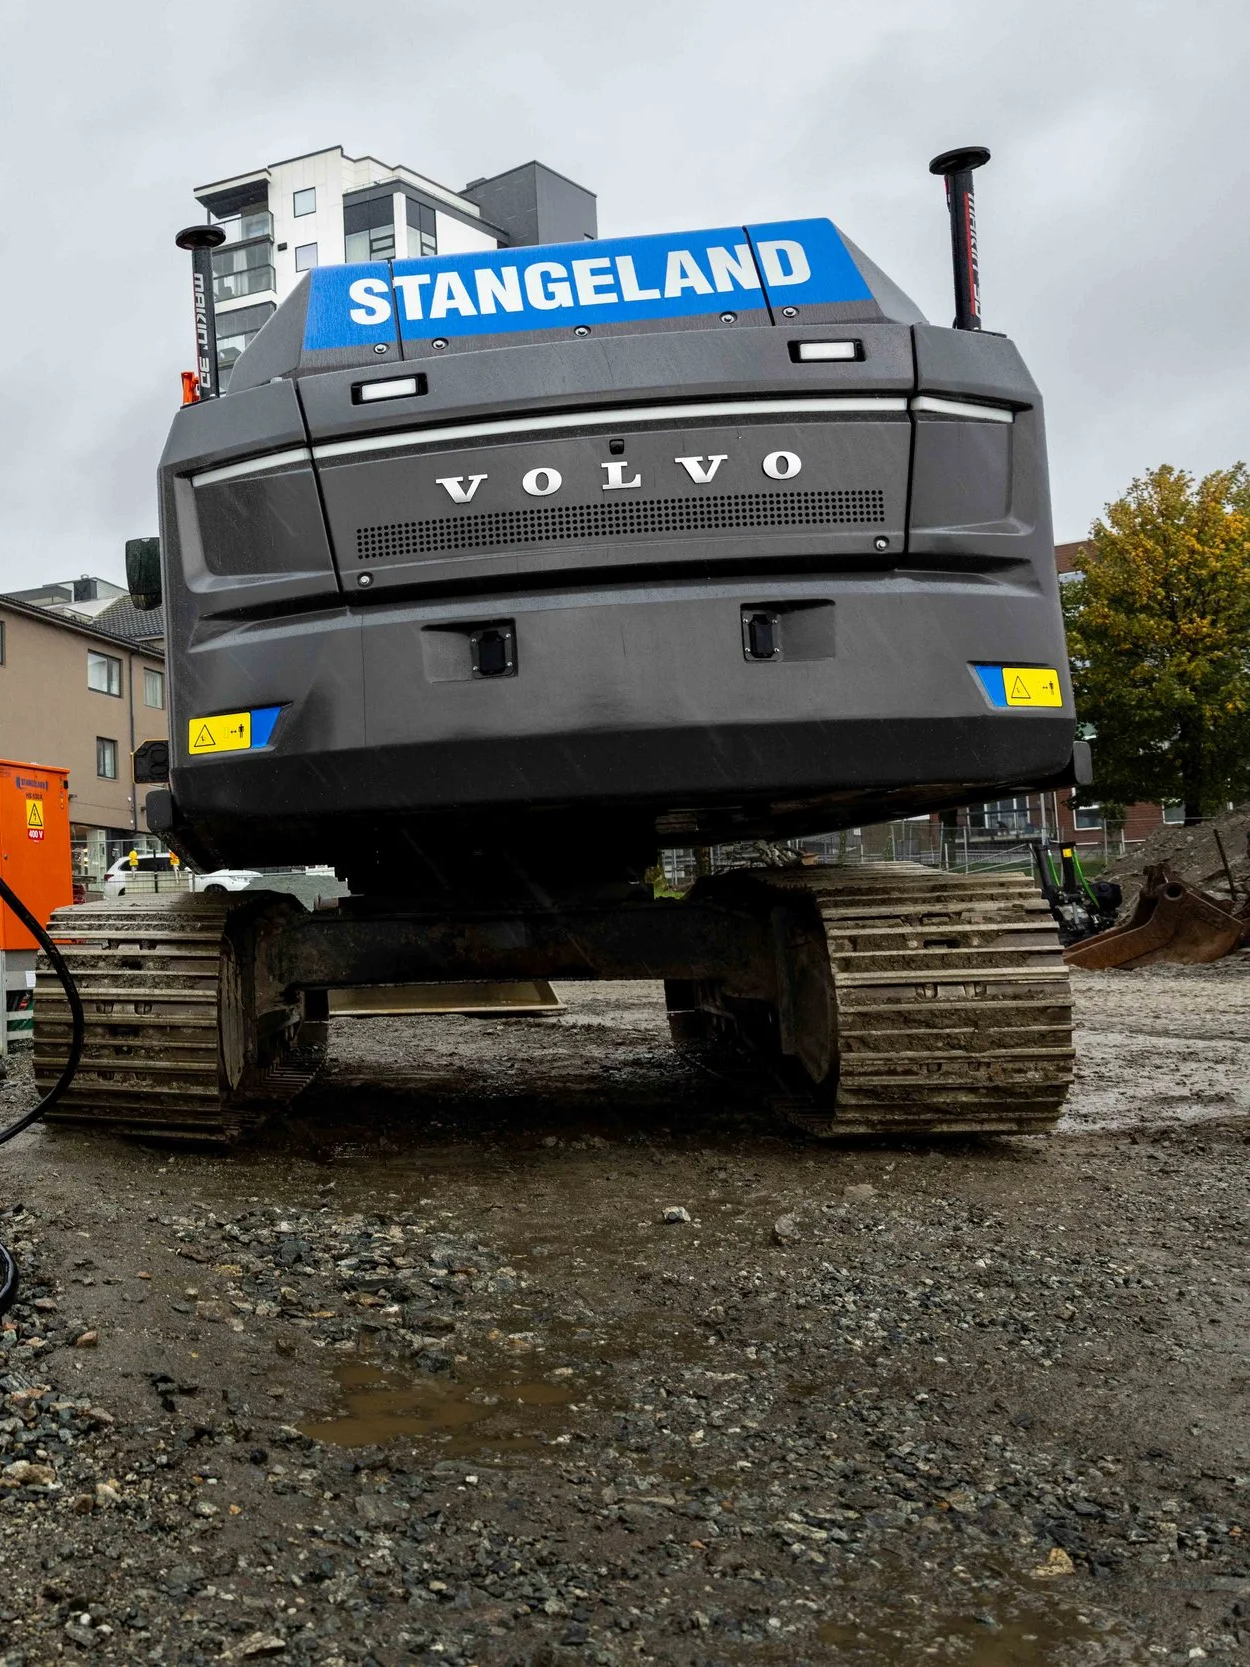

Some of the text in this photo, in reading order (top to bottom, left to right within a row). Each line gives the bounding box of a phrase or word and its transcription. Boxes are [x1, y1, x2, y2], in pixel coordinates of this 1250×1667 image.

[349, 239, 812, 326] STANGELAND
[199, 355, 211, 389] 3D
[435, 450, 803, 504] VOLVO
[29, 829, 44, 838] 400 V
